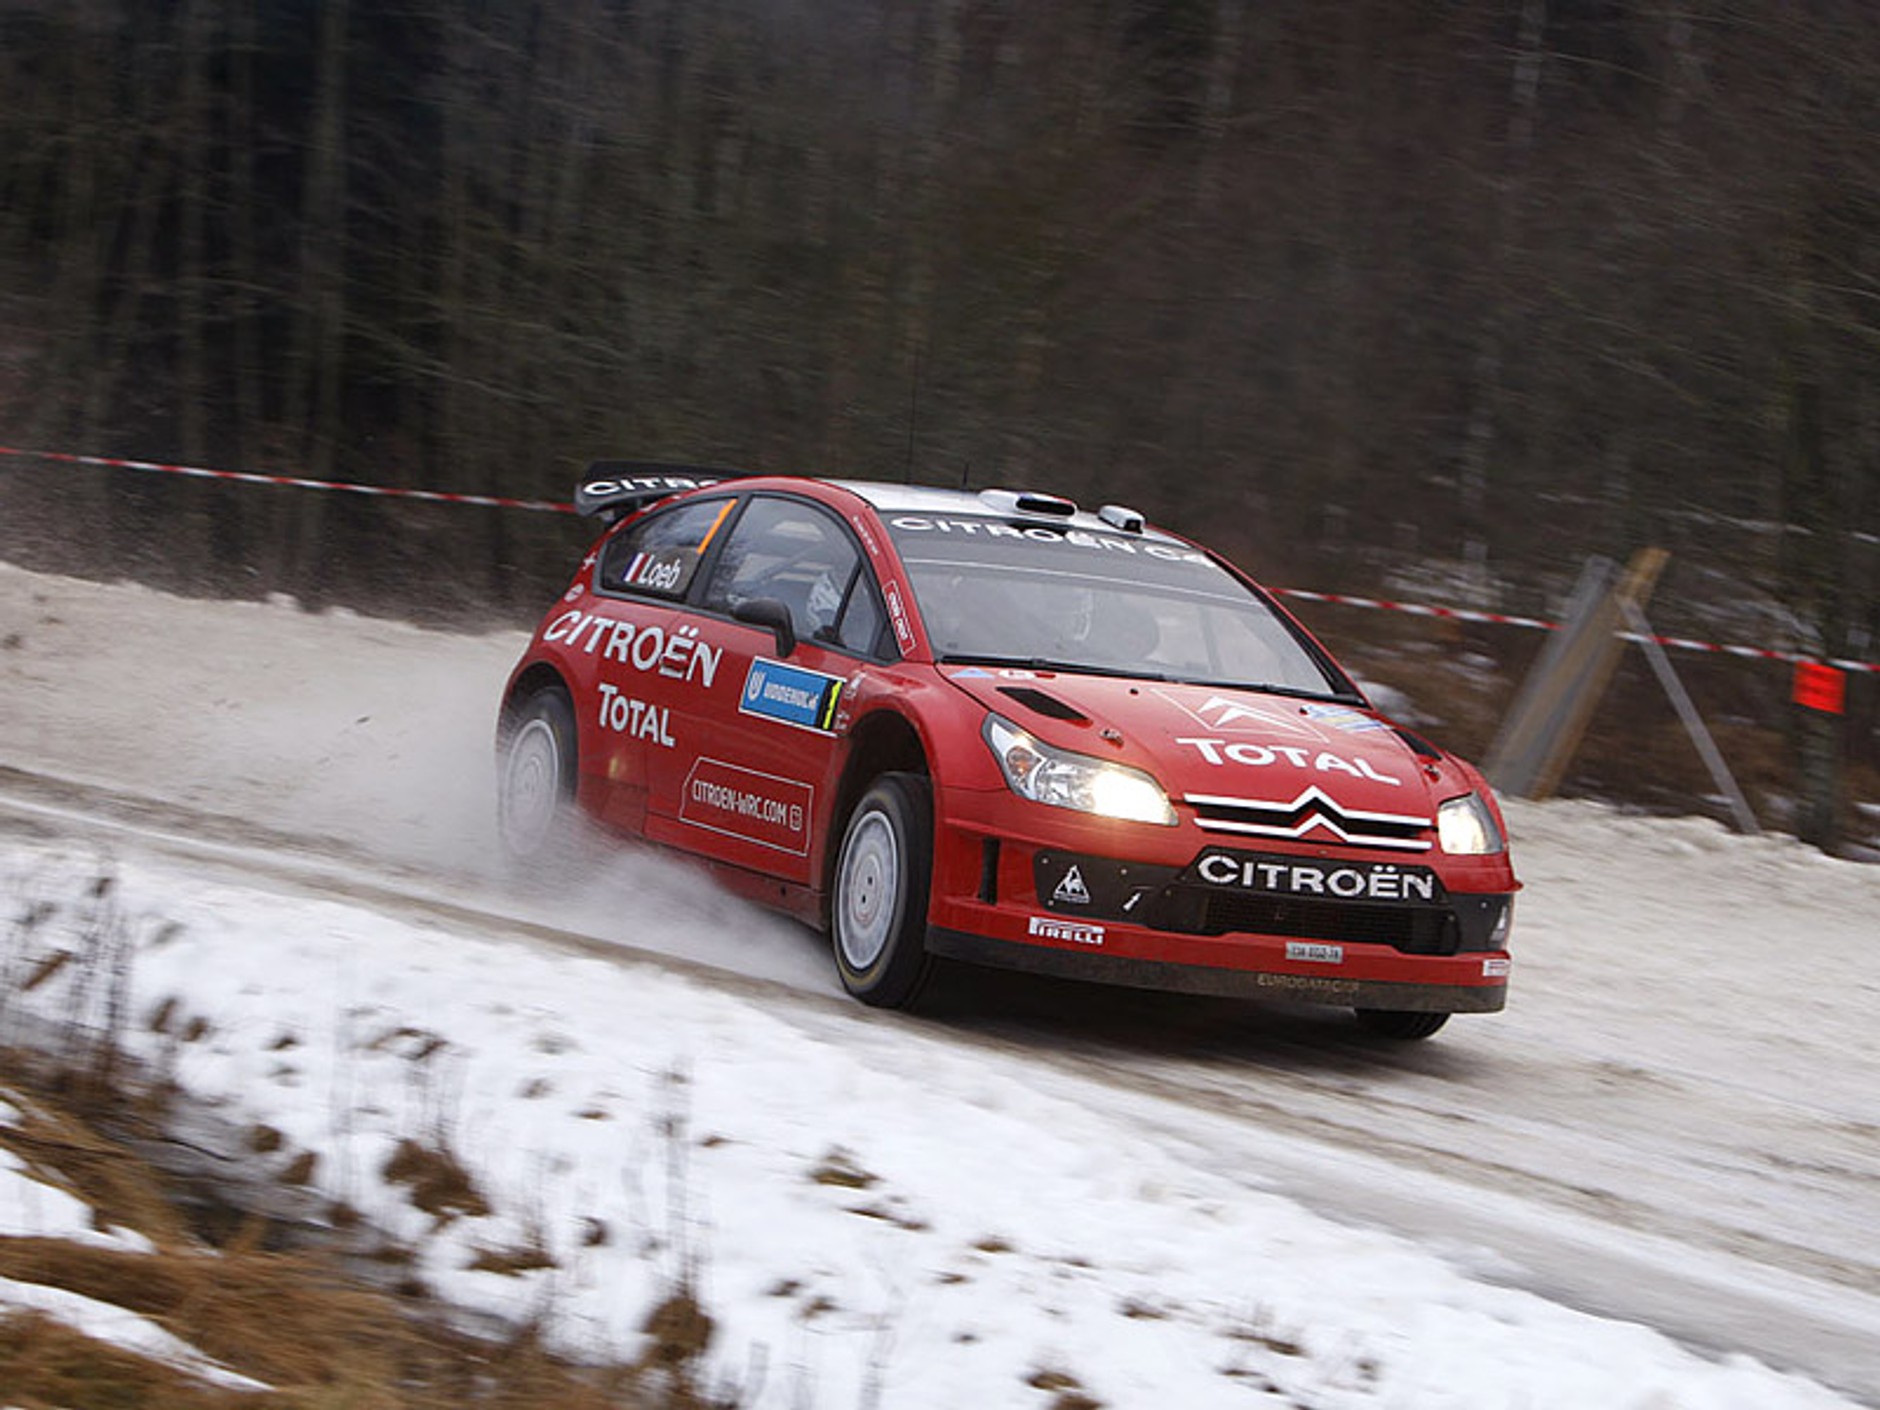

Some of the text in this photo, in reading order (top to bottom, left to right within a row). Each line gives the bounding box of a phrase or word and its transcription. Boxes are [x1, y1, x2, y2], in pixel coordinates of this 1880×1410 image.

[637, 554, 681, 589] Loeb
[543, 610, 723, 688] CITROËN
[598, 683, 676, 747] TOTAL
[1176, 738, 1401, 786] TOTAL
[1199, 855, 1433, 899] CITROËN
[1029, 916, 1105, 944] PIRELLI
